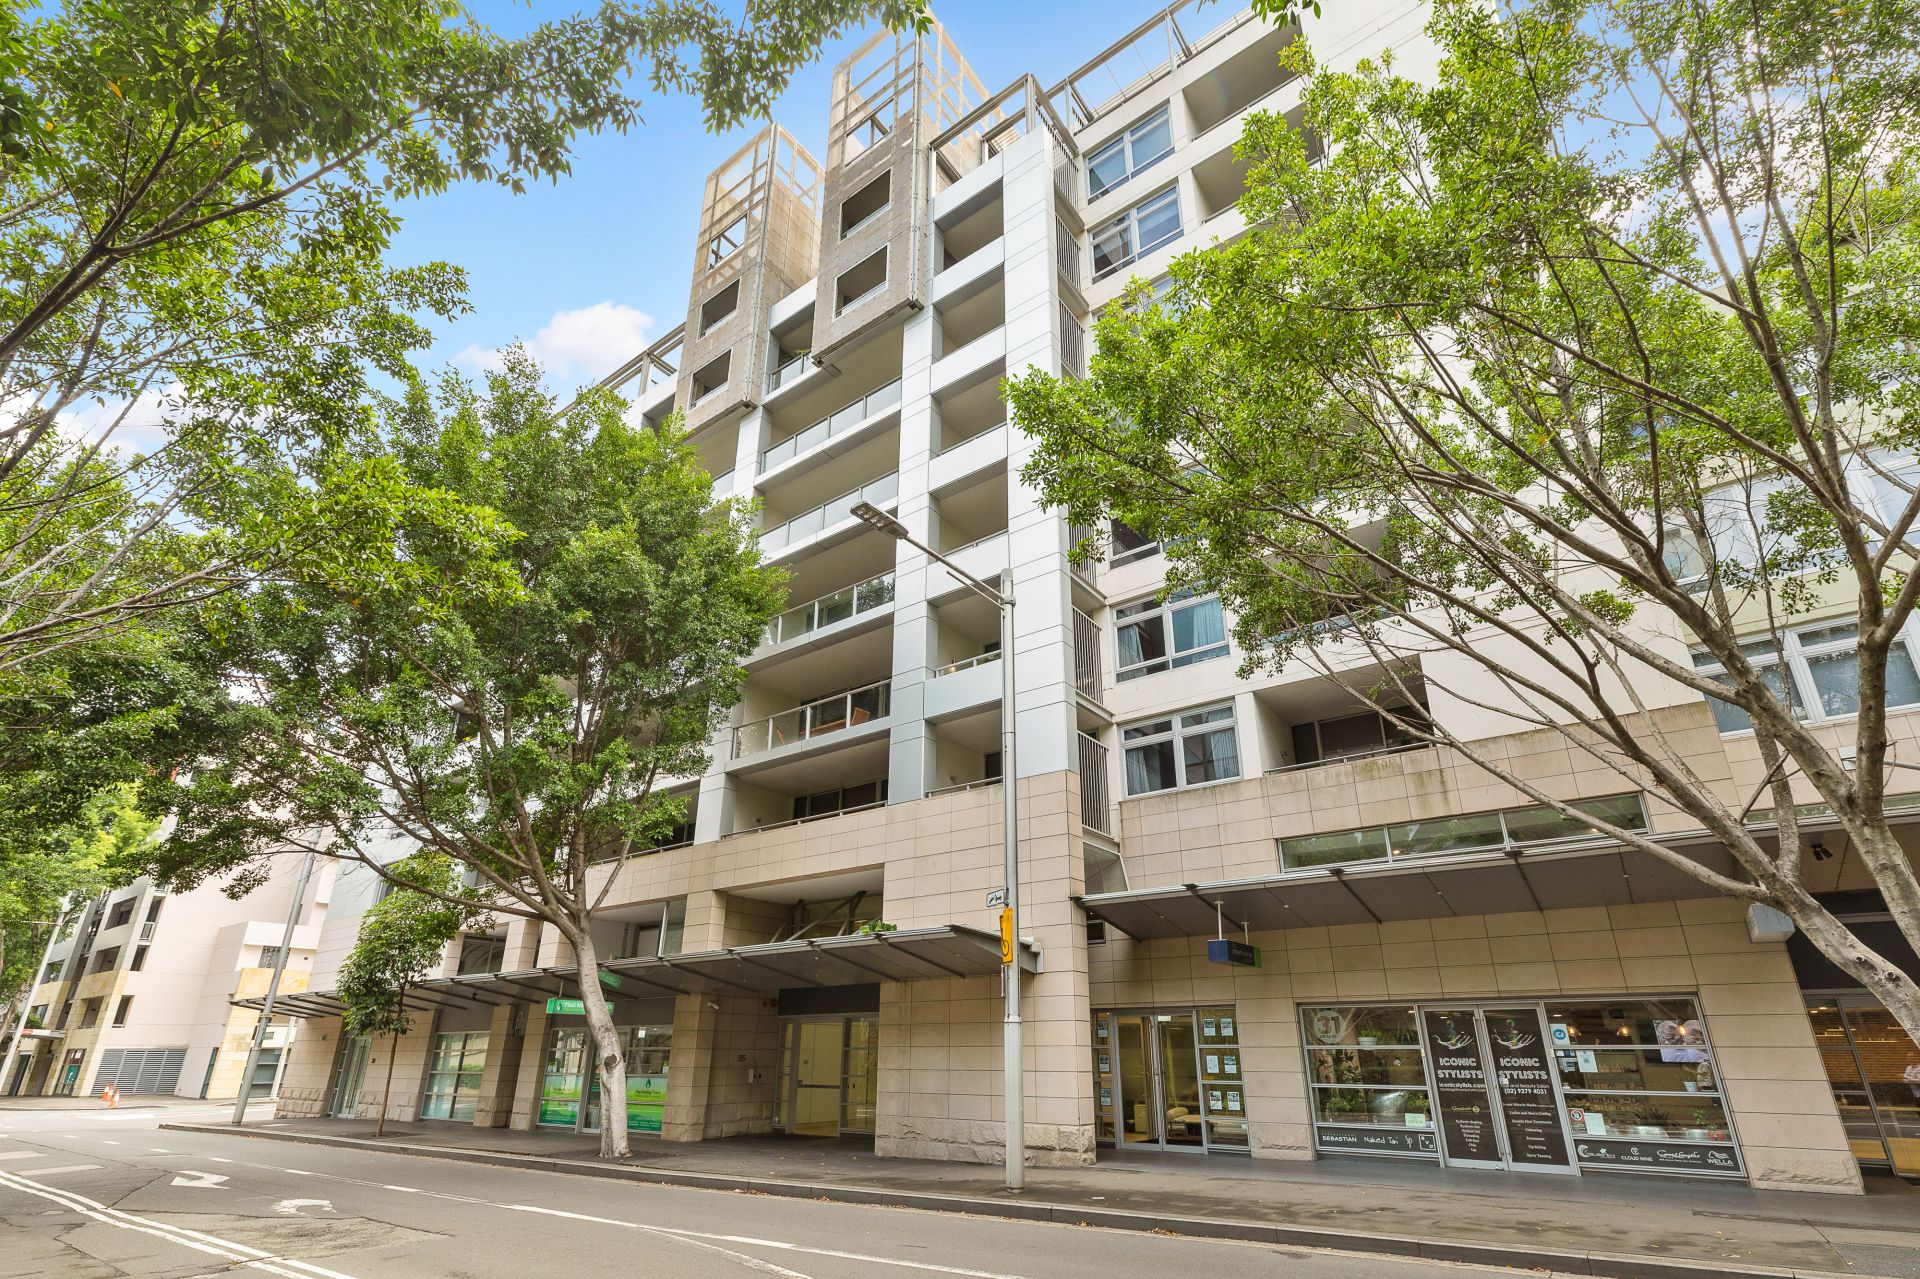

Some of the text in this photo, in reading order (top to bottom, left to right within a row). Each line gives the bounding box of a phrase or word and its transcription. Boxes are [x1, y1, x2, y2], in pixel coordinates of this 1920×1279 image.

[1439, 1057, 1477, 1066] ICONIC
[1500, 1057, 1540, 1067] ICONIC
[1437, 1070, 1484, 1079] STYLISTS
[1363, 1136, 1386, 1144] Naked
